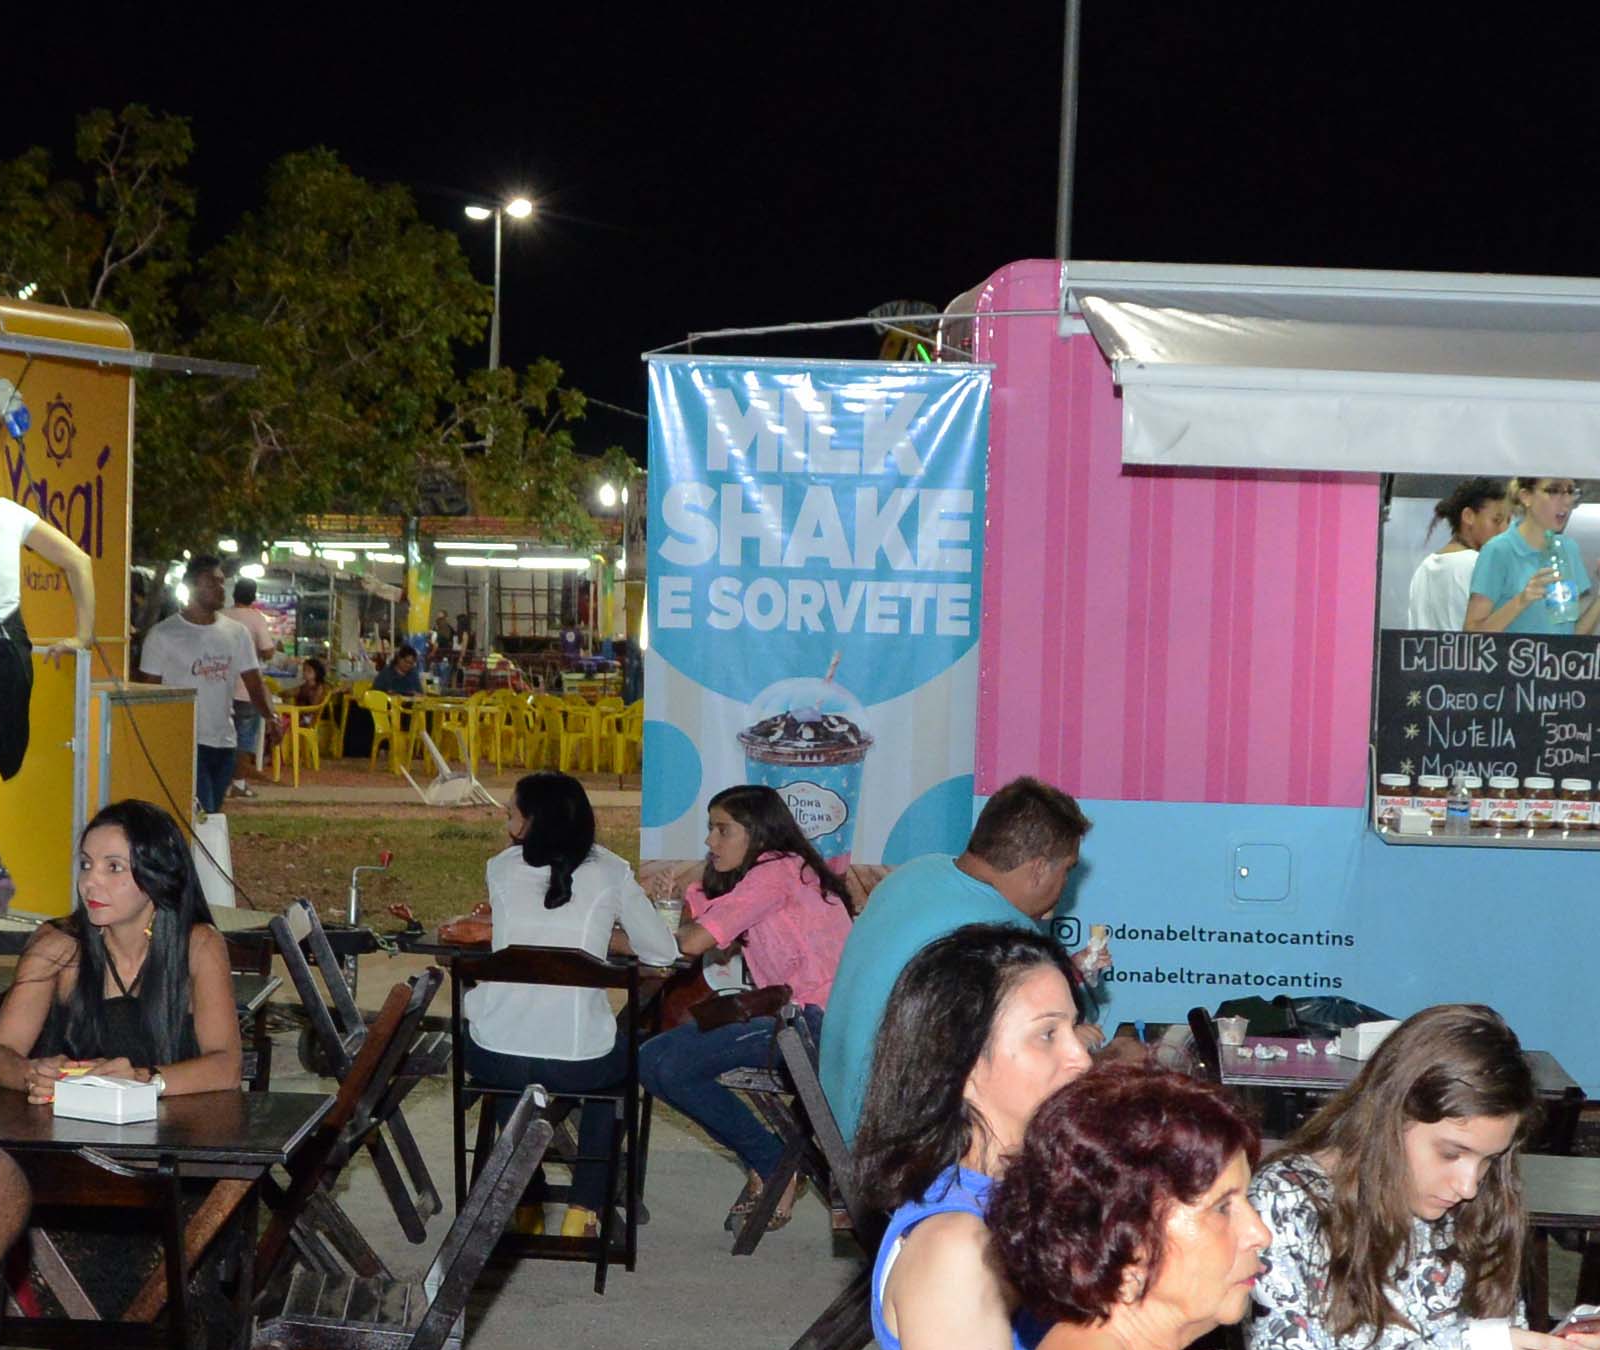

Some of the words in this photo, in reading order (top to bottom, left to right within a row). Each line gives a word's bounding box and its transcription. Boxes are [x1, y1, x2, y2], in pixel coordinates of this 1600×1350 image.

[707, 388, 928, 476] MILK
[657, 481, 975, 573] SHAKE
[657, 576, 693, 629] E
[706, 576, 972, 636] SORVETE
[787, 794, 822, 809] Dona
[794, 807, 832, 824] ltrana
[1100, 966, 1343, 989] donabeltranatocantins
